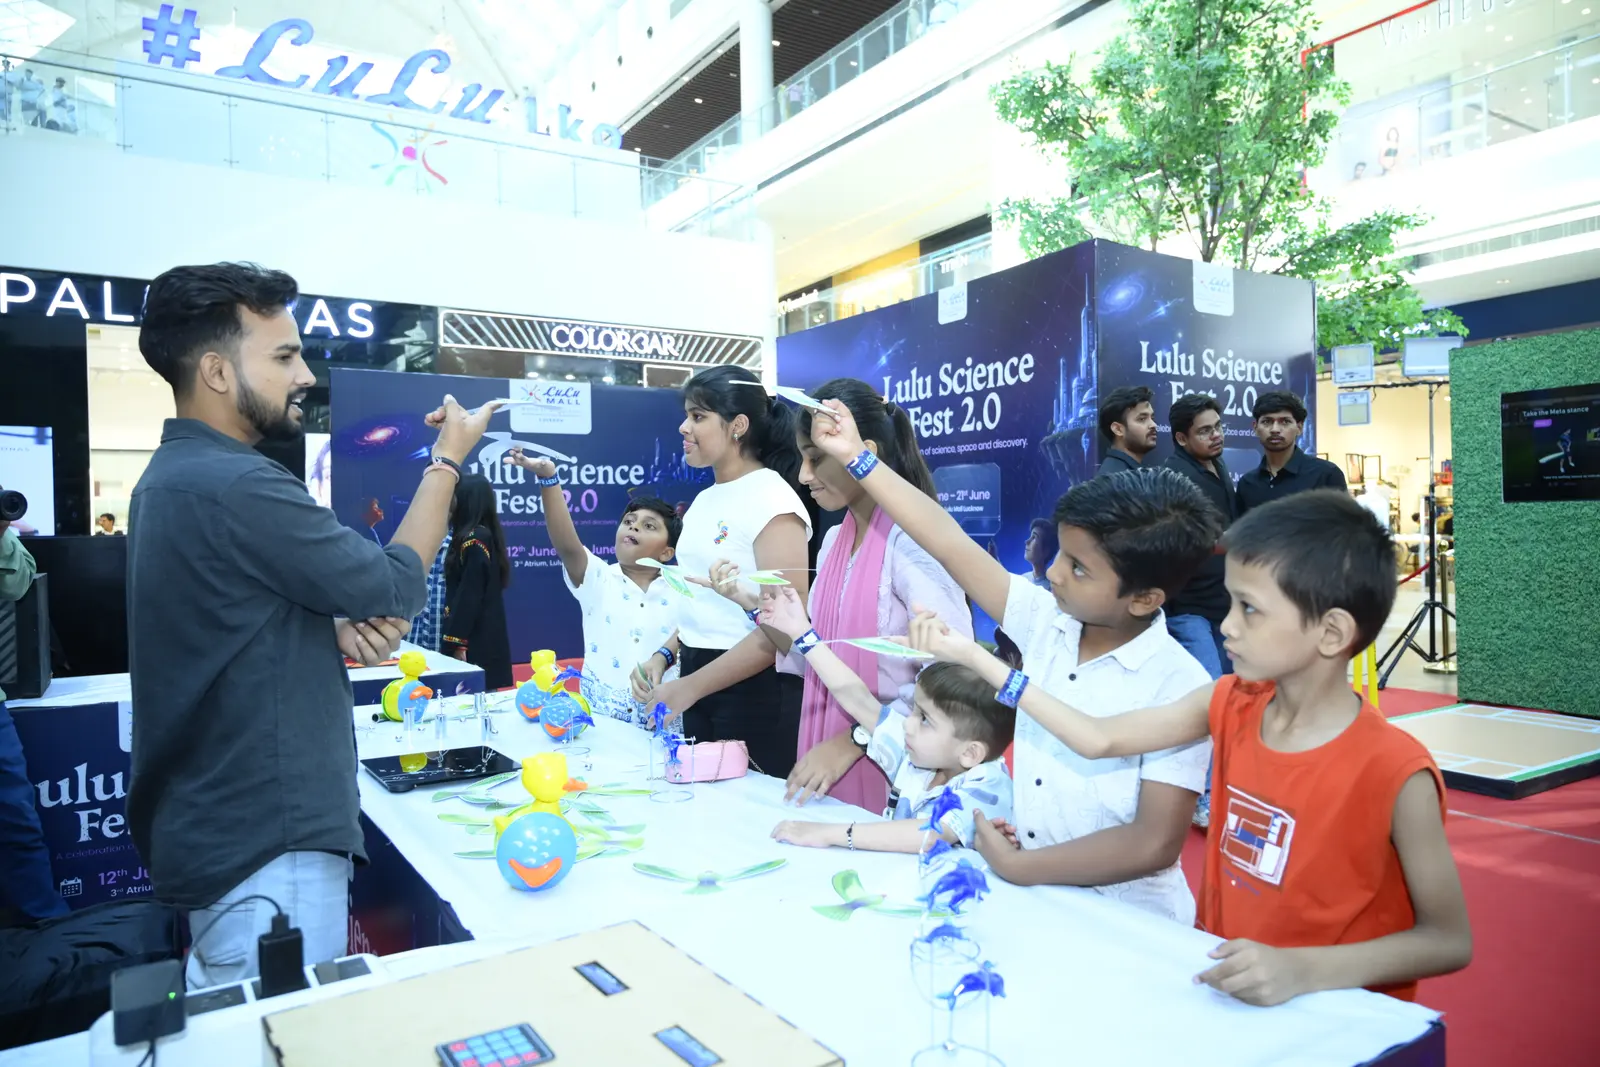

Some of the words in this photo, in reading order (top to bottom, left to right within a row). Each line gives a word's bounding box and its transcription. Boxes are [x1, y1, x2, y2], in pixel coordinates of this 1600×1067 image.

[1139, 341, 1196, 377] Lulu
[1202, 348, 1283, 385] Science
[883, 366, 932, 404] Lulu
[939, 353, 1035, 396] Science
[546, 397, 580, 405] MALL
[1223, 384, 1257, 417] 2.0
[907, 406, 954, 439] Fest
[960, 392, 1001, 433] 2.0
[925, 446, 932, 456] of
[932, 445, 957, 456] science,
[957, 443, 977, 455] space
[978, 440, 992, 451] and
[993, 438, 1029, 449] discovery.
[535, 456, 645, 485] cience
[969, 489, 991, 501] June
[506, 545, 526, 558] 12th
[528, 545, 557, 558] June
[34, 762, 127, 809] ulu
[74, 807, 131, 843] Fe
[98, 867, 128, 886] 12th
[126, 883, 154, 895] Atriu
